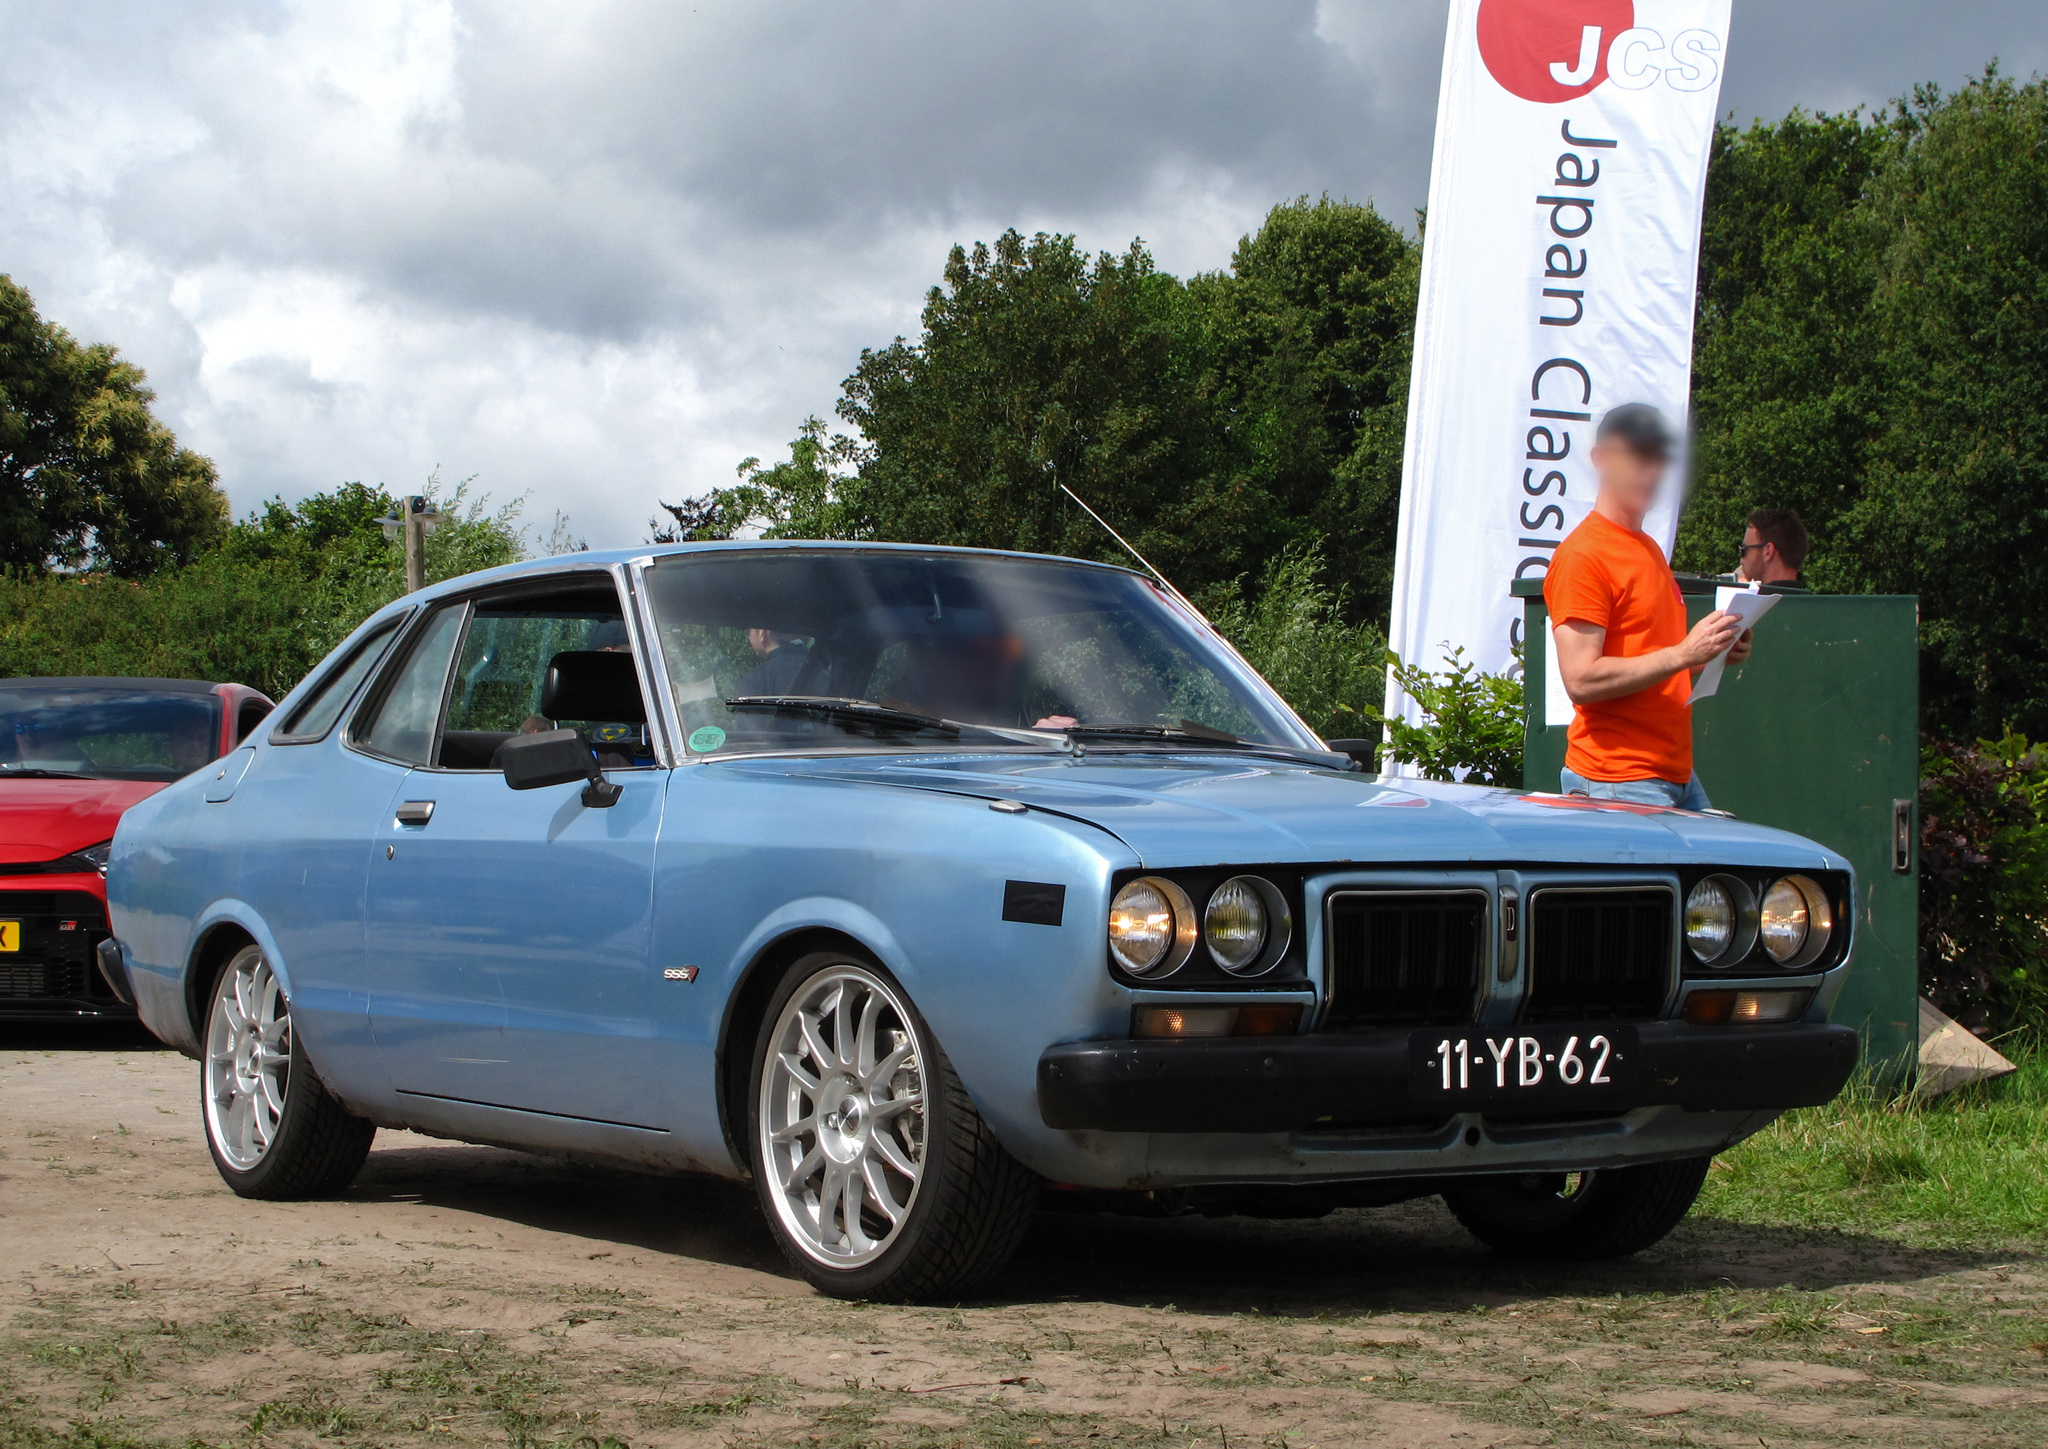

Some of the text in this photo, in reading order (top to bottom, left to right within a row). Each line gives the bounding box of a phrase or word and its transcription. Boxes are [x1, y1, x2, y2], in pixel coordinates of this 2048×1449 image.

[1549, 25, 1721, 92] JCS
[1536, 119, 1617, 326] Japan
[663, 967, 690, 979] SSS
[1437, 1035, 1611, 1089] 11-YB-62
